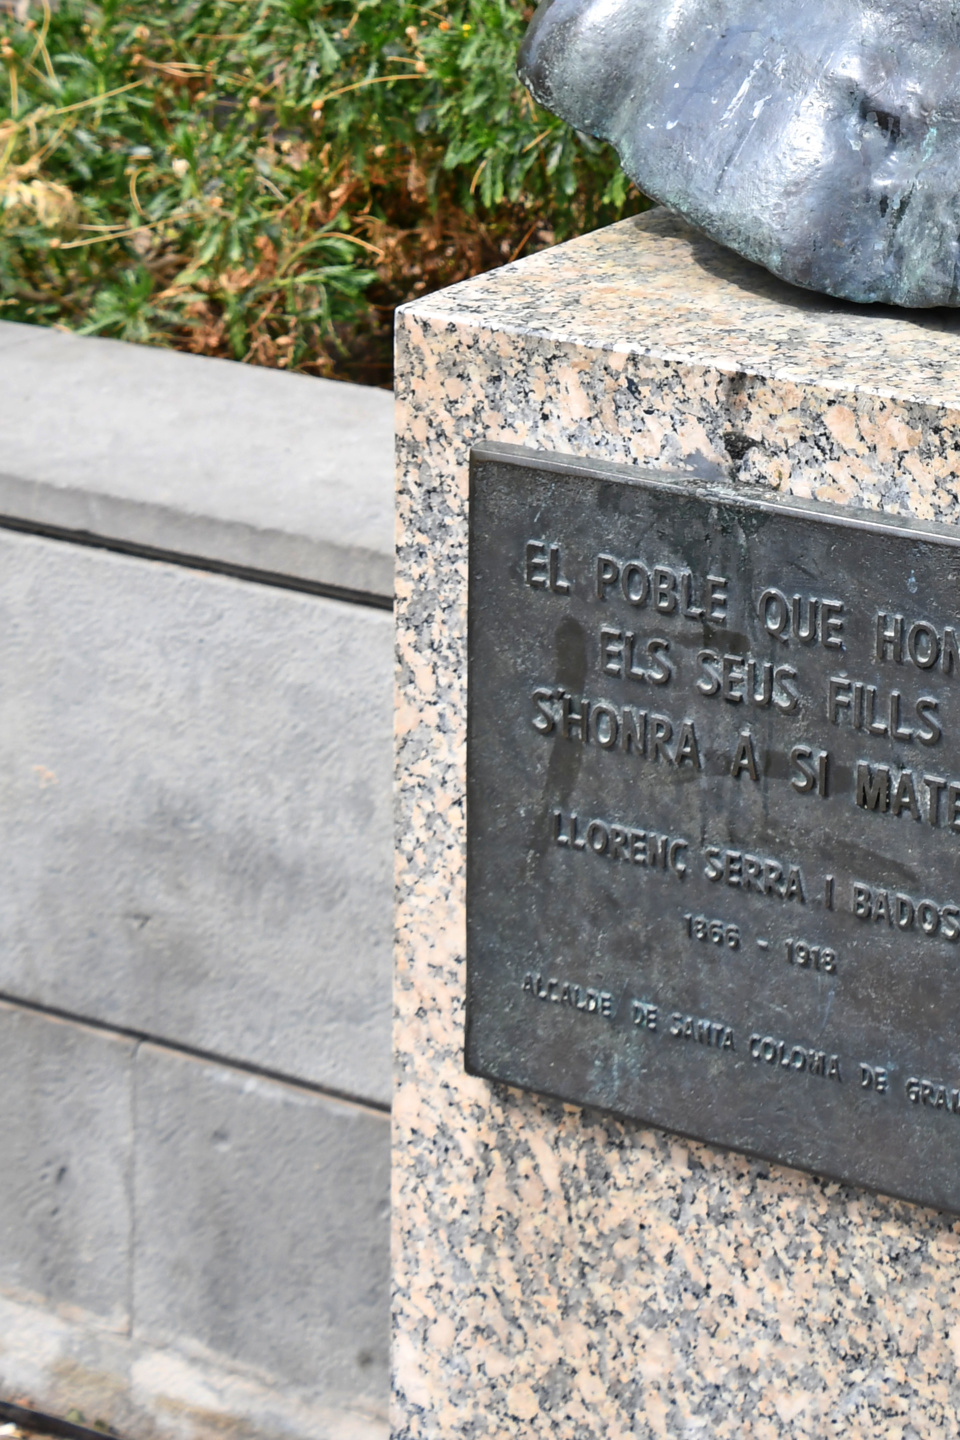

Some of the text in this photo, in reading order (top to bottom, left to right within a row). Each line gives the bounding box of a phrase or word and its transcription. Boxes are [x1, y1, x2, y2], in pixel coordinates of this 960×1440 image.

[525, 540, 569, 594] EL
[597, 553, 727, 626] POBLE
[758, 587, 845, 649] QUE
[601, 623, 941, 745] ELS SEUS FILLS
[731, 731, 758, 781] A
[790, 744, 830, 797] SI
[553, 811, 688, 879] LLORENÇ
[704, 848, 803, 904] SERRA
[824, 874, 834, 910] I
[785, 938, 837, 975] 1918
[521, 971, 612, 1018] ALCALDE
[632, 1000, 658, 1031] DE
[670, 1012, 736, 1052] SANTA
[749, 1033, 842, 1083] COLOMA
[860, 1062, 887, 1093] DE
